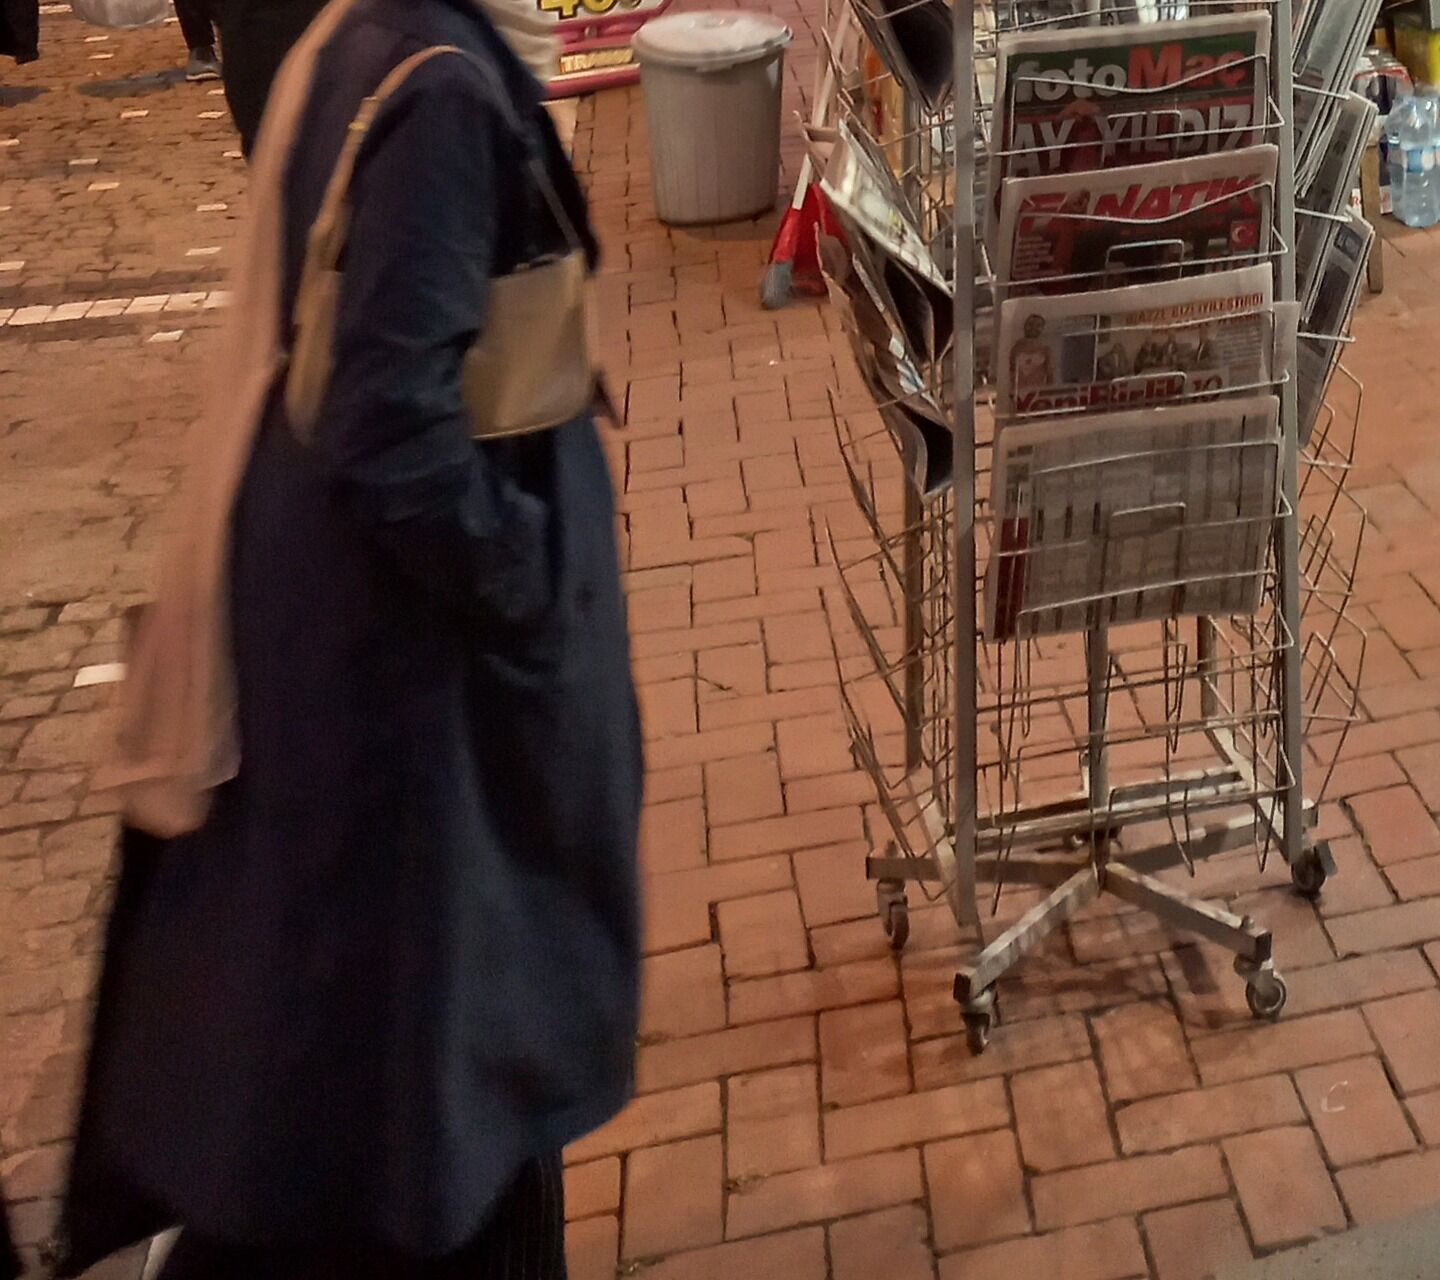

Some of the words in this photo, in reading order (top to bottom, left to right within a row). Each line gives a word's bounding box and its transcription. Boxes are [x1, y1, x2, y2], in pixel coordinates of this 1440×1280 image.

[1013, 43, 1246, 103] fotoMaç
[1009, 118, 1076, 179] AY
[1095, 103, 1253, 160] YILDIZ
